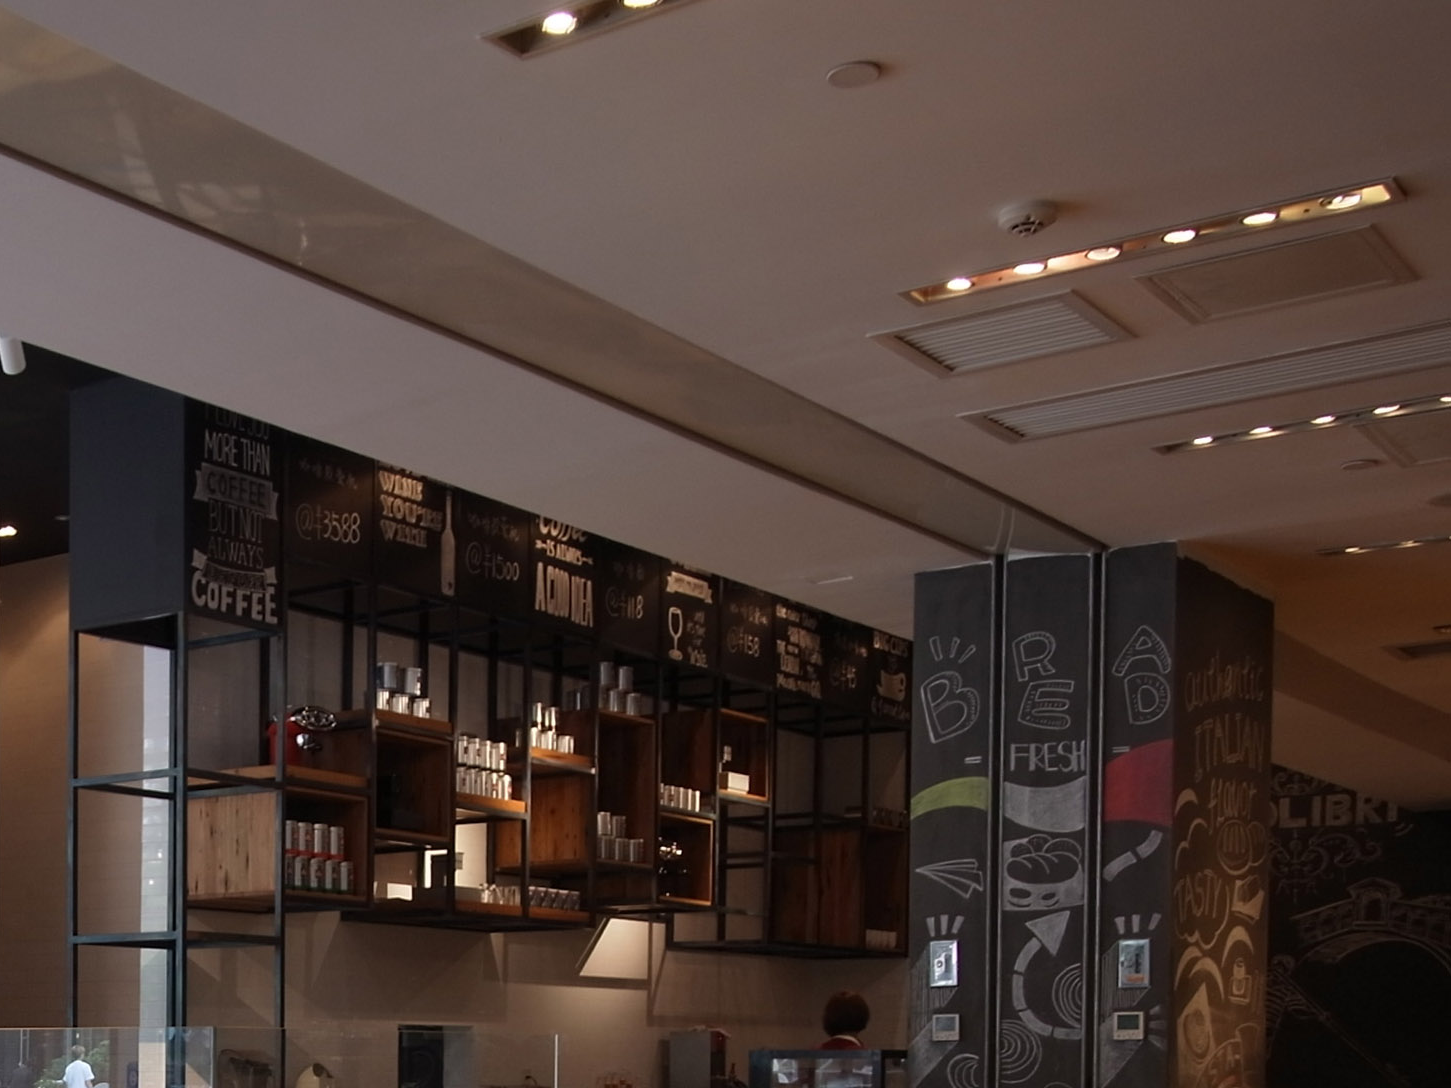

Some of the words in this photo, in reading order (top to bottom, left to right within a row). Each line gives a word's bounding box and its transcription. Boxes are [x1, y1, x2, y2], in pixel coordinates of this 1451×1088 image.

[204, 427, 239, 467] MORE
[240, 437, 270, 477] THAN
[207, 472, 267, 506] COFFEE
[208, 499, 237, 537] BUT
[239, 508, 263, 543] NOT
[207, 535, 264, 569] ALWAYS
[191, 570, 278, 624] COFFEE
[1185, 650, 1264, 712] authentic
[1010, 740, 1085, 772] FRESH
[1194, 713, 1265, 784] ITALIAN
[1174, 870, 1222, 923] TASTY
